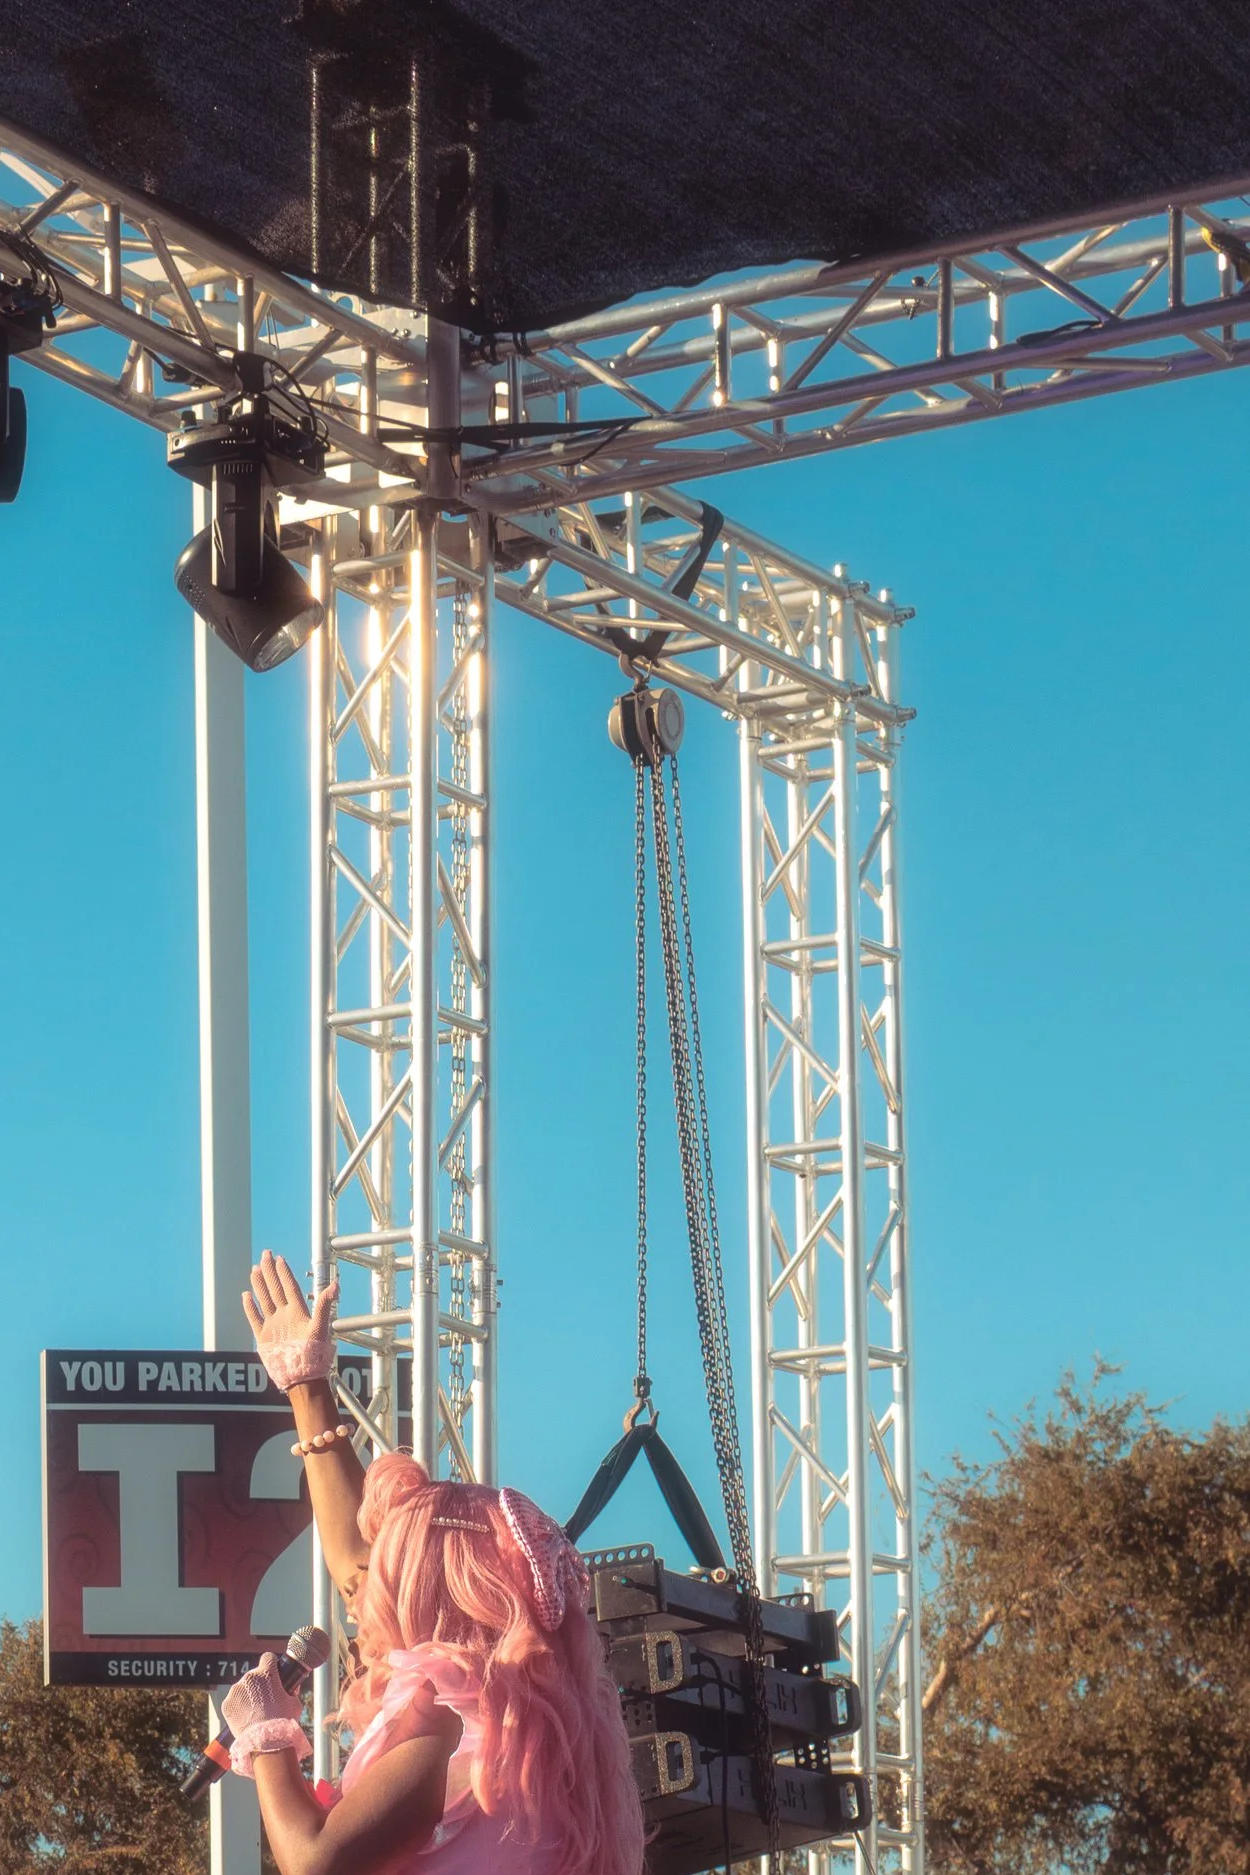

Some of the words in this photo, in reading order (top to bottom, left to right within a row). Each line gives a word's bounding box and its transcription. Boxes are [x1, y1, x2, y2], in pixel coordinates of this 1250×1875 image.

[59, 1360, 126, 1392] YOU
[138, 1361, 268, 1393] PARKED
[107, 1660, 198, 1677] SECURITY
